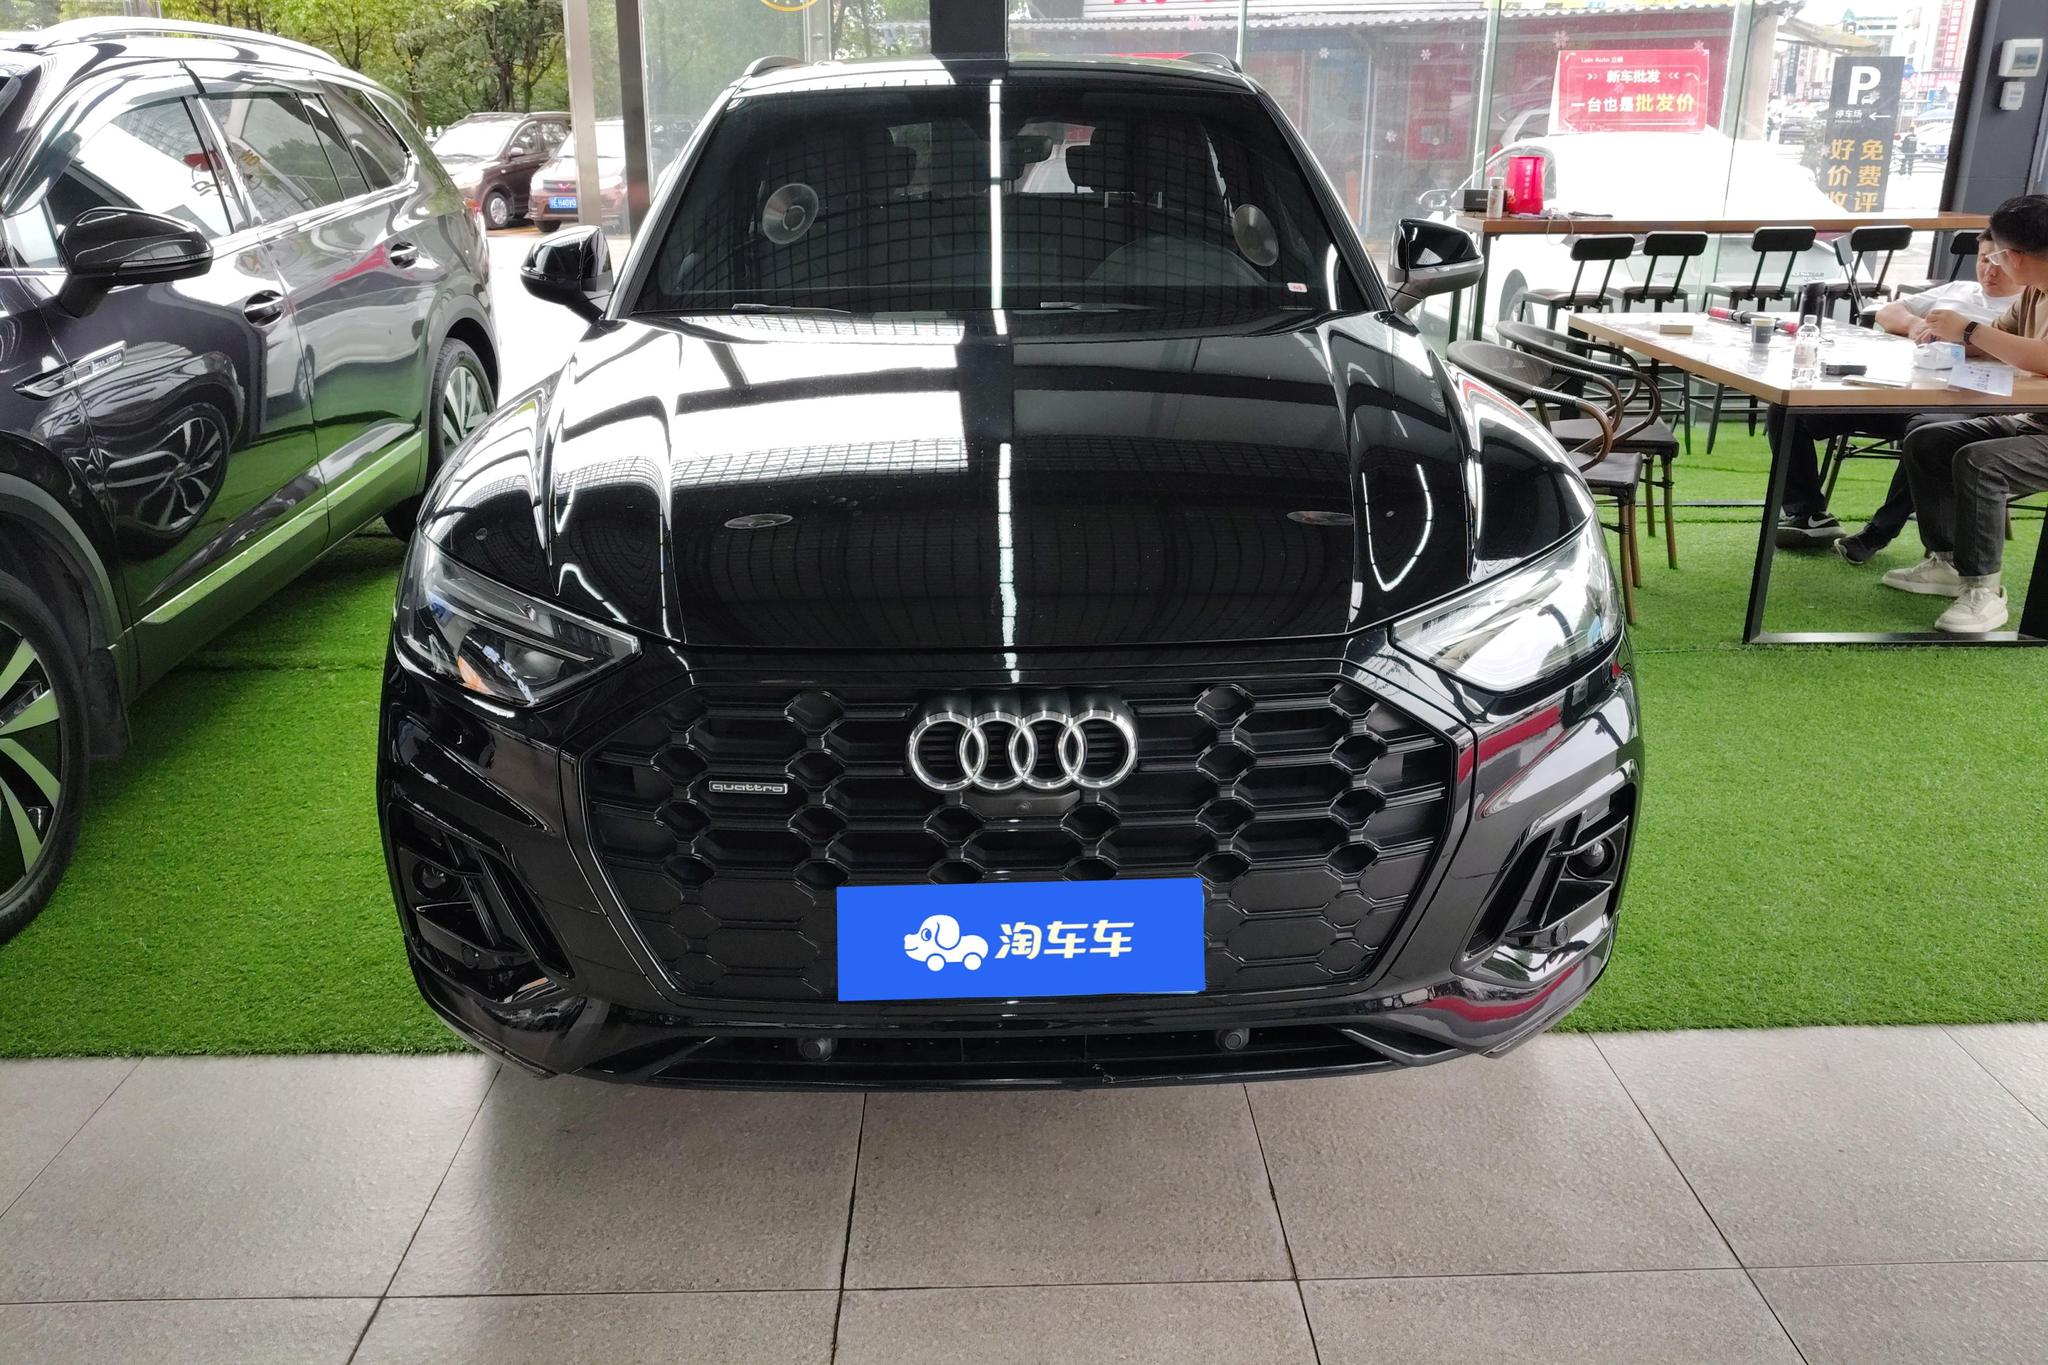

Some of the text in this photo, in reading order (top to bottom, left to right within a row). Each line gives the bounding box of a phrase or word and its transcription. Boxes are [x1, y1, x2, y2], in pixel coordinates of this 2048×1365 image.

[1606, 69, 1661, 83] 新车批发
[1847, 65, 1881, 105] P
[1570, 93, 1696, 113] 一台也是批发价
[1835, 109, 1862, 119] 停车场
[711, 783, 785, 793] quattro
